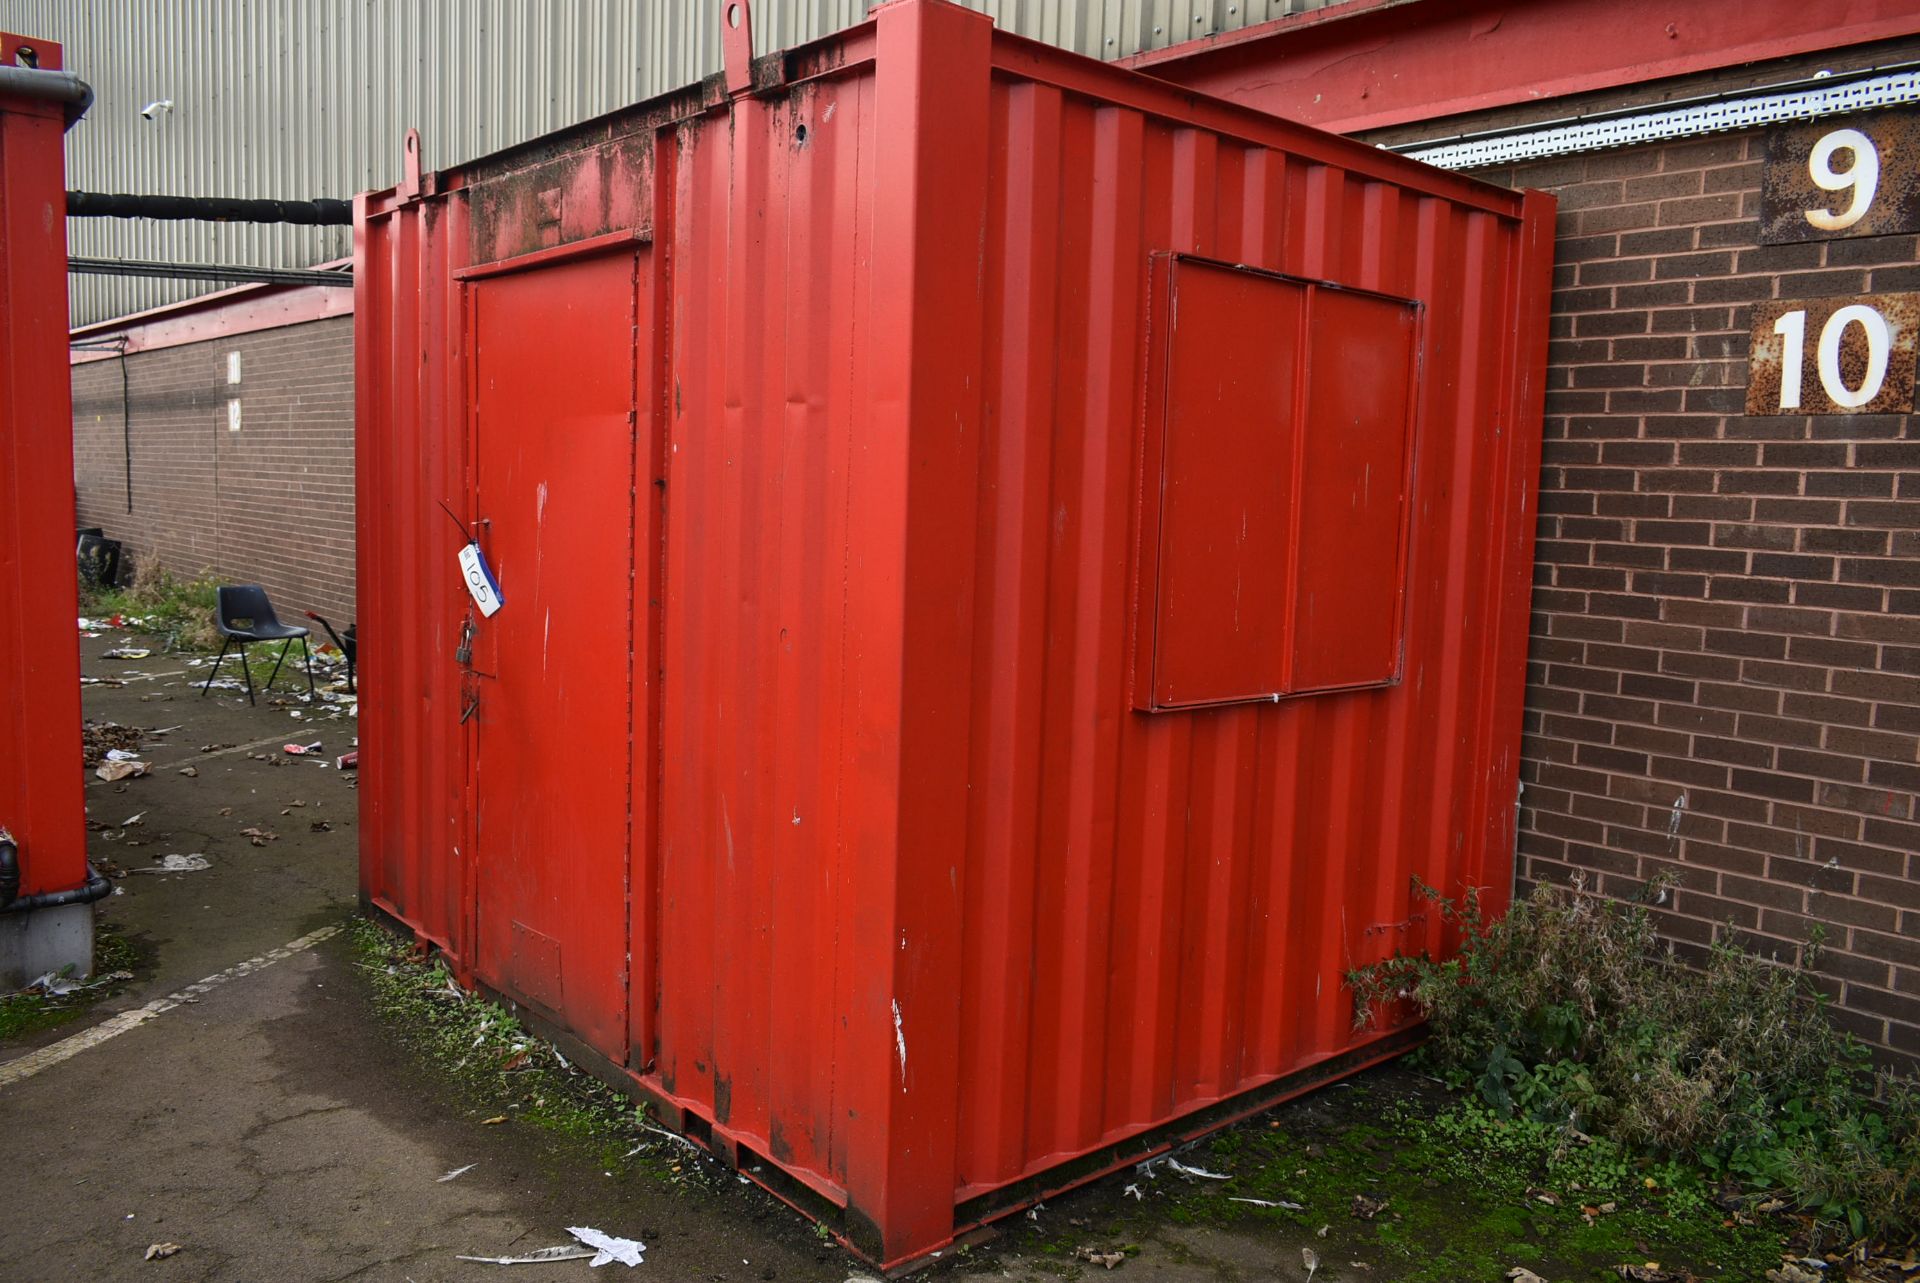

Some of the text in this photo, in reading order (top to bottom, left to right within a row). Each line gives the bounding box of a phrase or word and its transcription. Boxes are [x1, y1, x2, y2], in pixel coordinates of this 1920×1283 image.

[1805, 128, 1880, 231] 9
[1774, 304, 1890, 408] 10
[466, 562, 489, 603] 105
